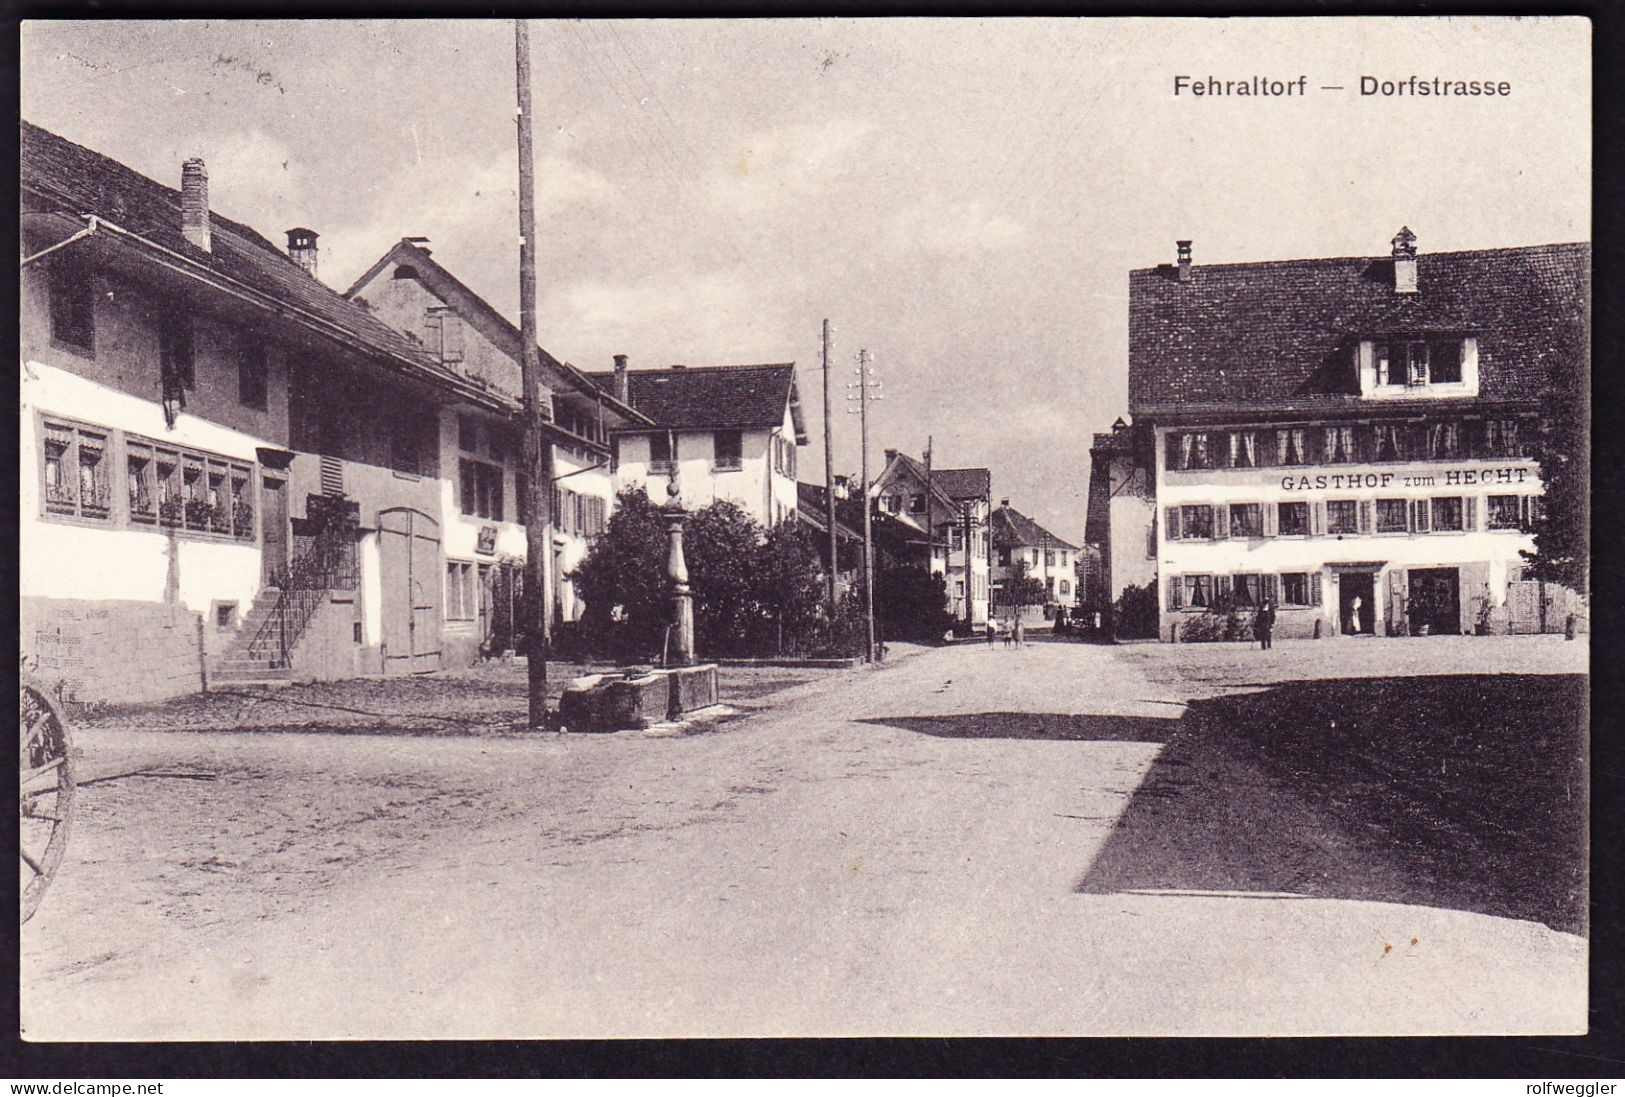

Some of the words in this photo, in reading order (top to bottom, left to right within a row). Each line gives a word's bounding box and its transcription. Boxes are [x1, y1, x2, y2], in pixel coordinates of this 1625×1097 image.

[1280, 473, 1395, 491] GASTHOF
[1403, 475, 1436, 488] zum
[1444, 467, 1529, 486] HECHT
